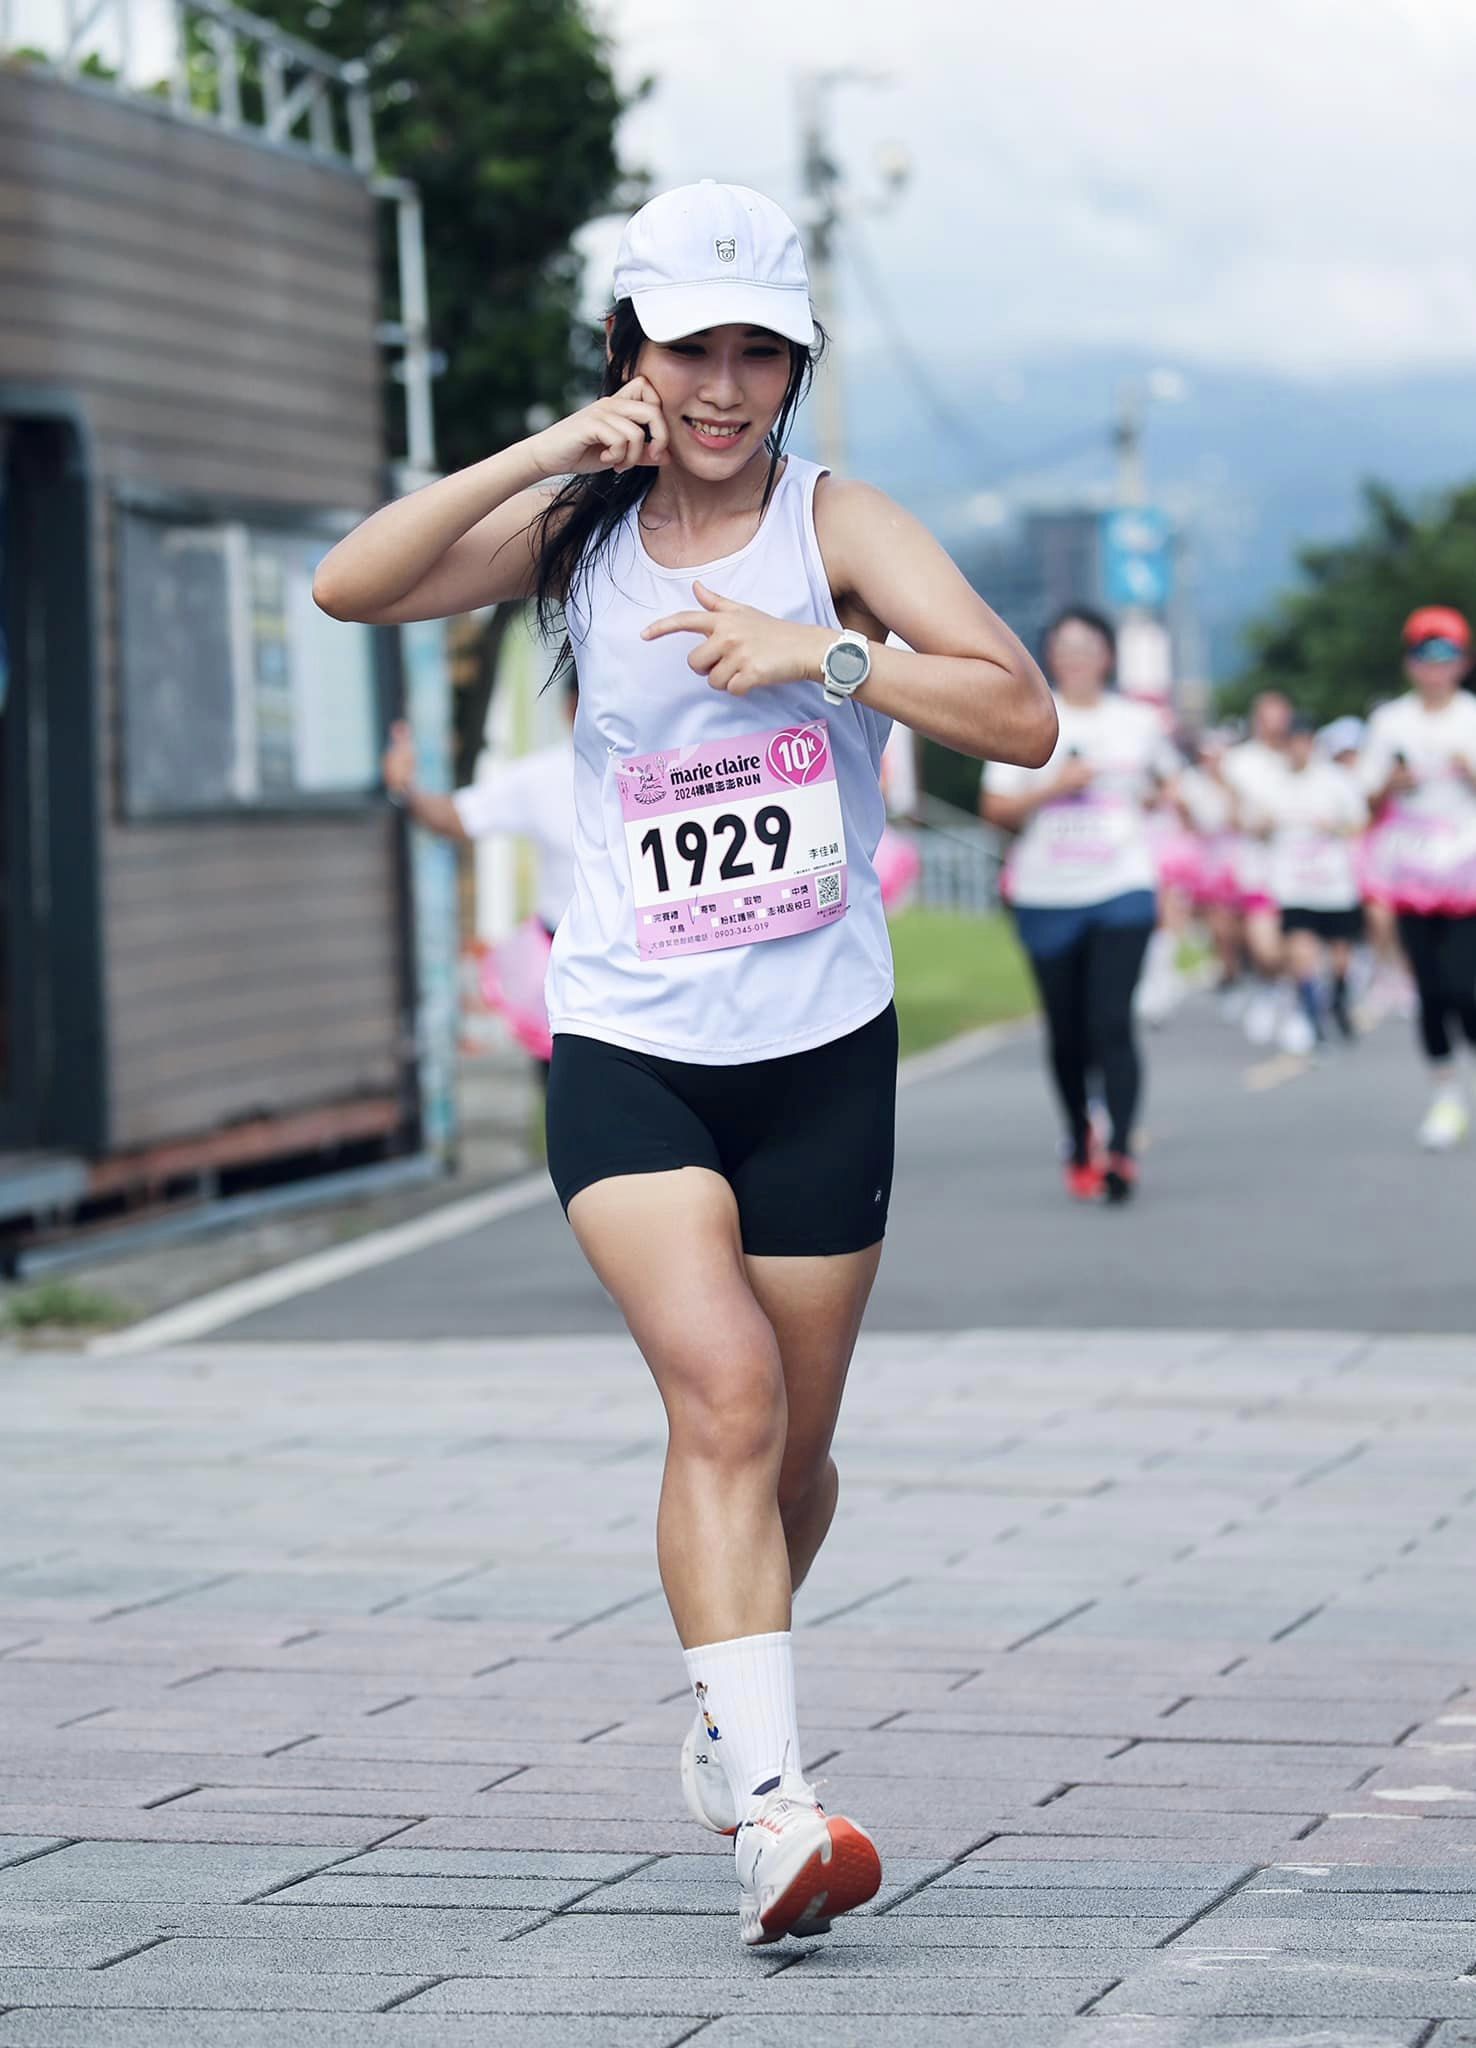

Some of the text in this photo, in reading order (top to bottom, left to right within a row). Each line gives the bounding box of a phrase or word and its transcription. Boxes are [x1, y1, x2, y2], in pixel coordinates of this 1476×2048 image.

[670, 755, 761, 785] marie claire
[641, 805, 791, 892] 1929
